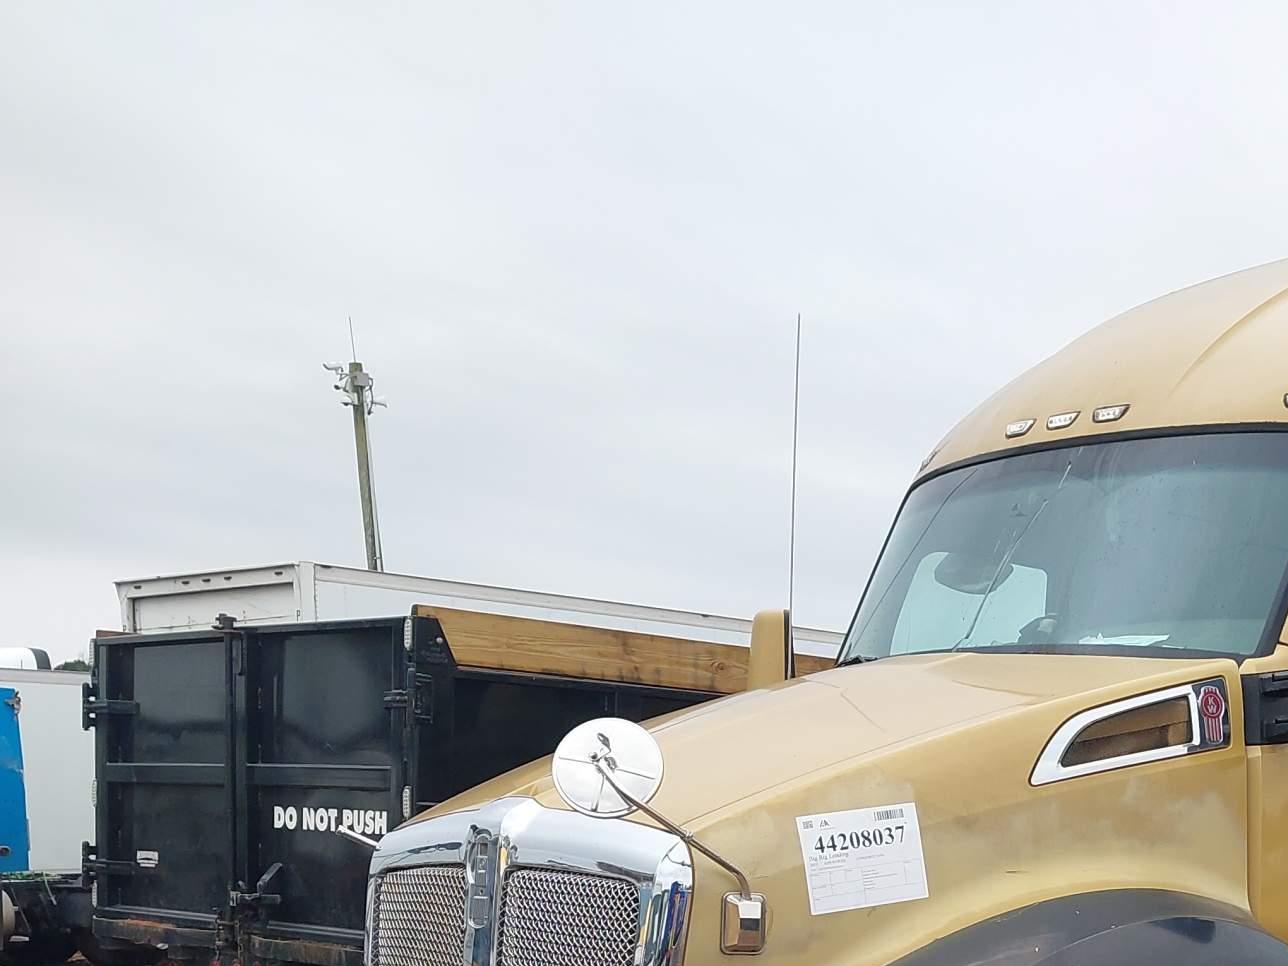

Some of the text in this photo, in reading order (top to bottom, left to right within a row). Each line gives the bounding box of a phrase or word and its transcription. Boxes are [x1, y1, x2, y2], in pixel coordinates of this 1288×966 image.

[273, 805, 388, 835] DO NOT PUSH
[814, 825, 905, 854] 44208037
